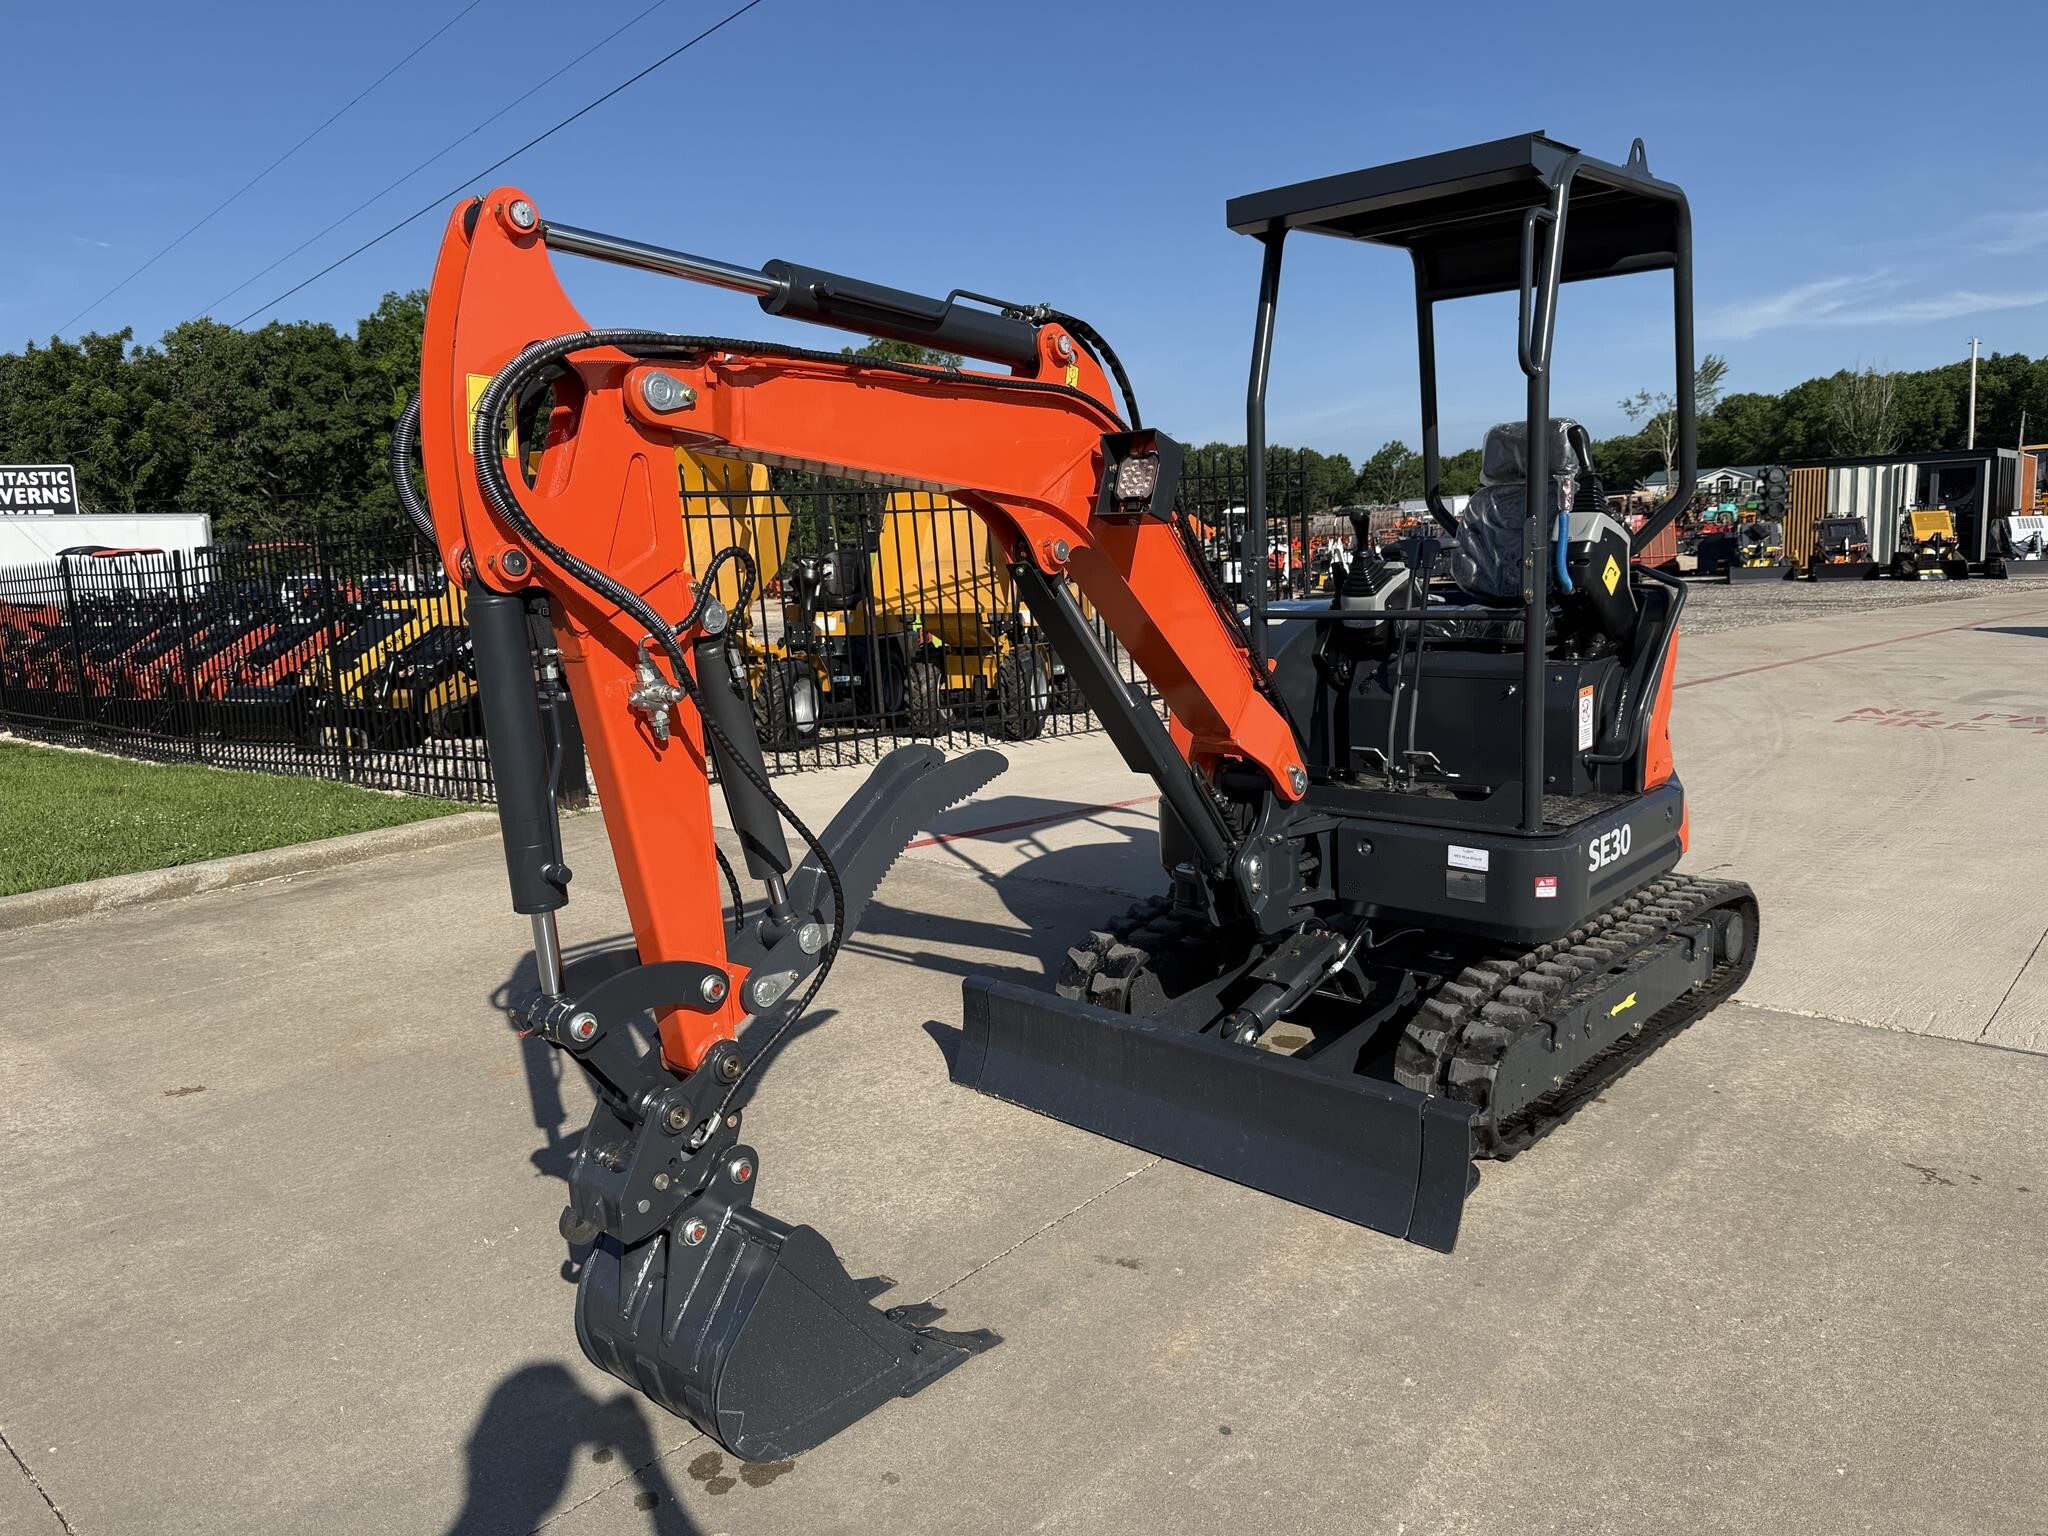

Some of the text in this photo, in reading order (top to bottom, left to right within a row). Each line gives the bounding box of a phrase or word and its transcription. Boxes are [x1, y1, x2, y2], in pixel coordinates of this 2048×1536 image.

[0, 486, 71, 505] VERNS
[1851, 706, 1944, 718] NO
[1832, 714, 2001, 732] FIRE
[1588, 823, 1632, 872] SE30
